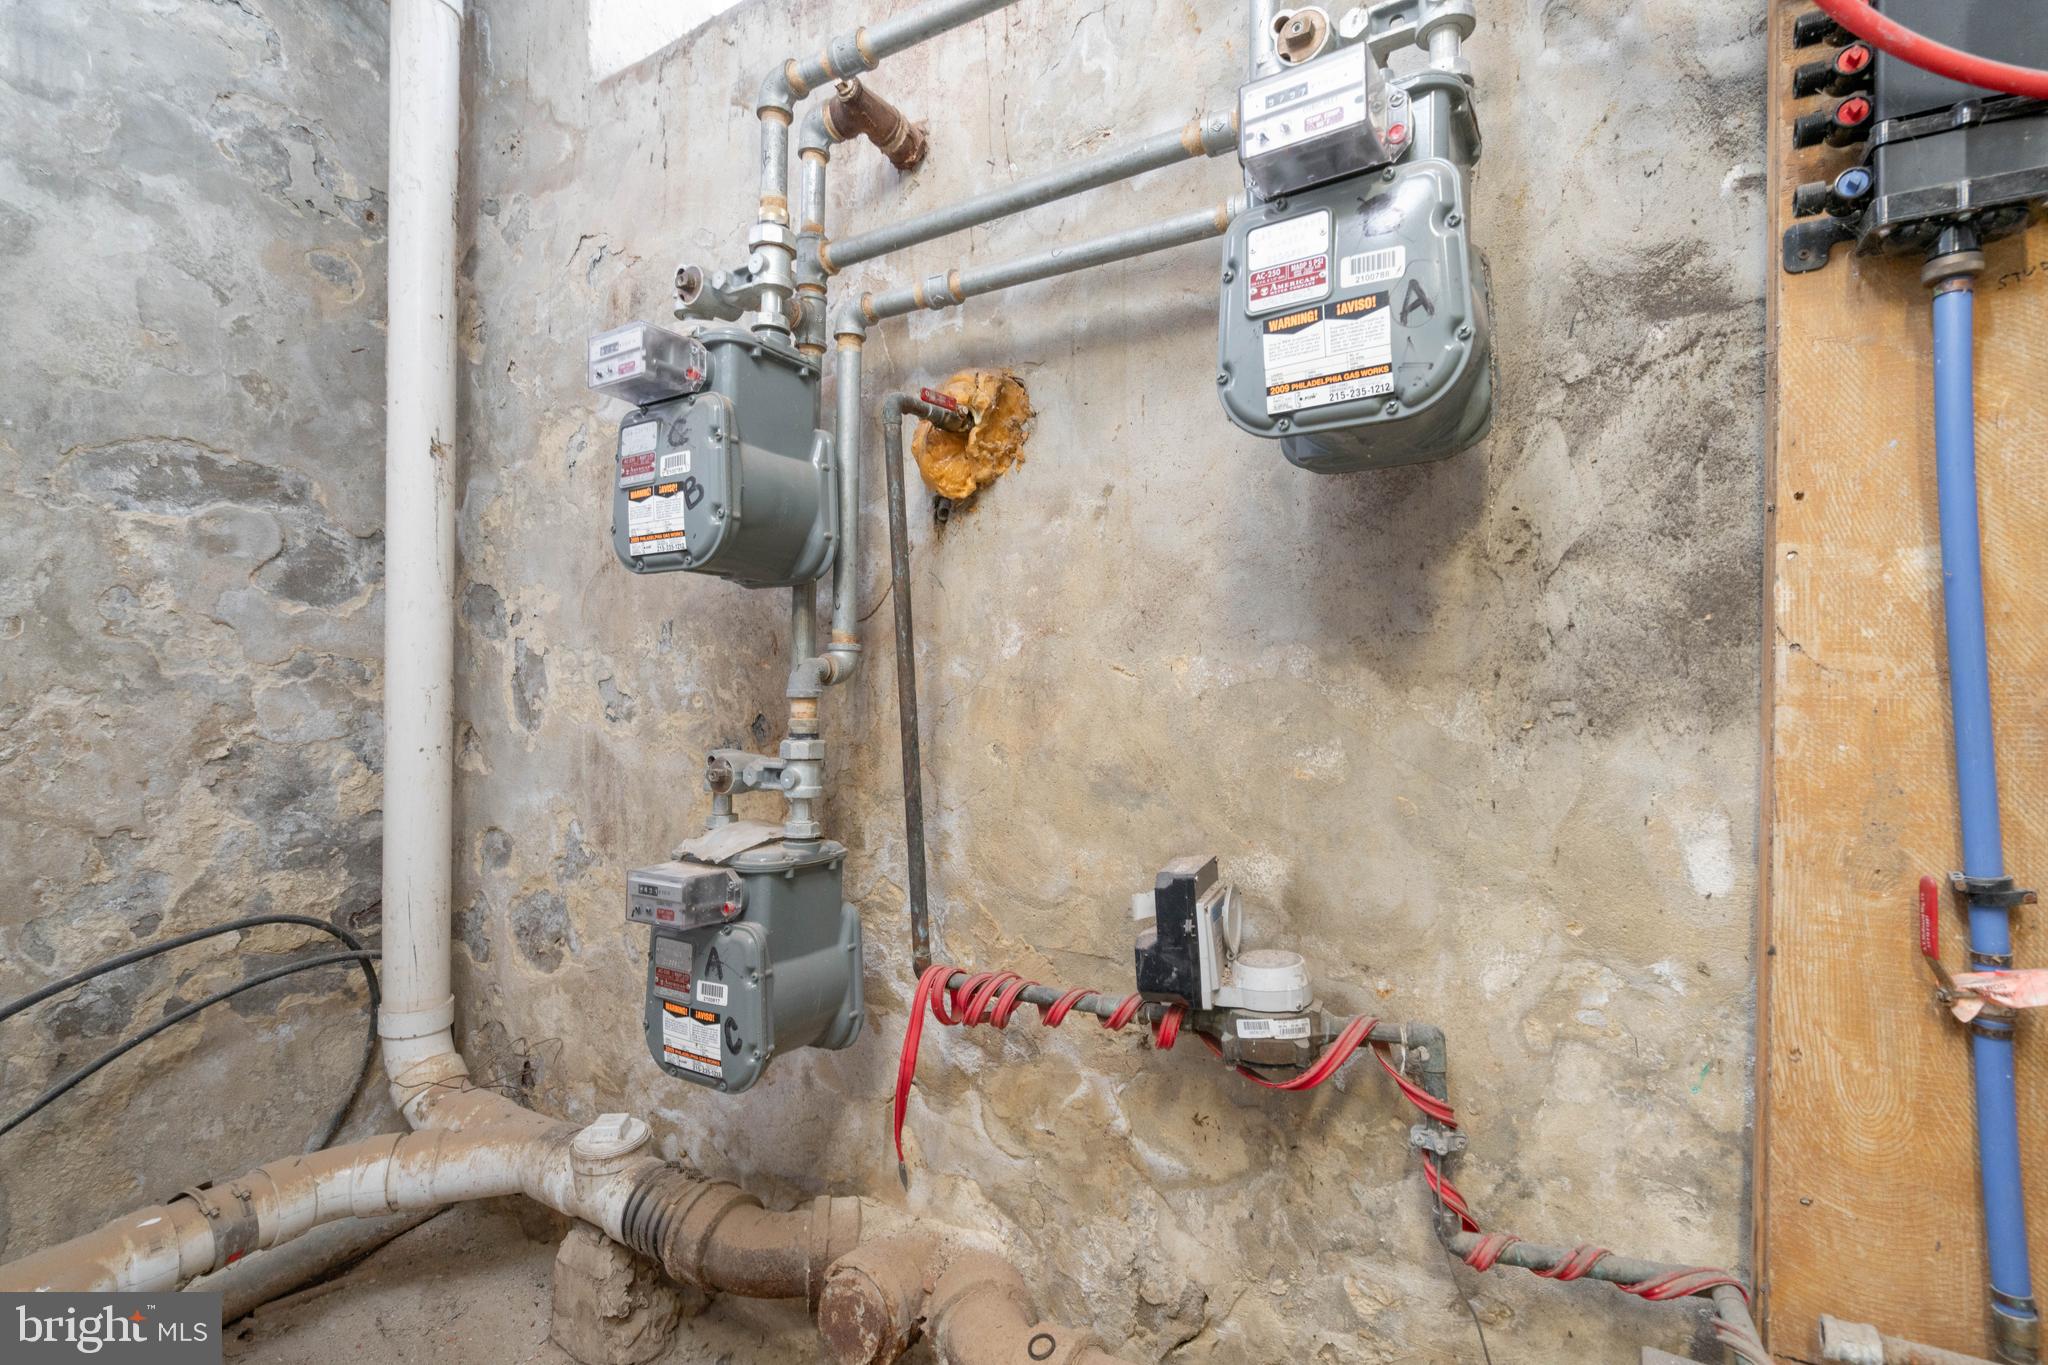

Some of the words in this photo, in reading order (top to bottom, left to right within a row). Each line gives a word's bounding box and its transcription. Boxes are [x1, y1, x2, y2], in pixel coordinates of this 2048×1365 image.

[1255, 269, 1281, 281] AC-250
[1336, 295, 1377, 316] ¡AVISO!
[1400, 279, 1435, 327] A
[1268, 309, 1318, 332] WARNING!
[1270, 384, 1290, 396] 2009
[1291, 373, 1343, 391] PHILADELPHIA
[1343, 369, 1360, 380] GAS
[1360, 364, 1389, 378] WORKS
[1329, 383, 1391, 402] 215-235-1212
[684, 476, 705, 510] B
[705, 946, 723, 981] A
[725, 1016, 743, 1055] C
